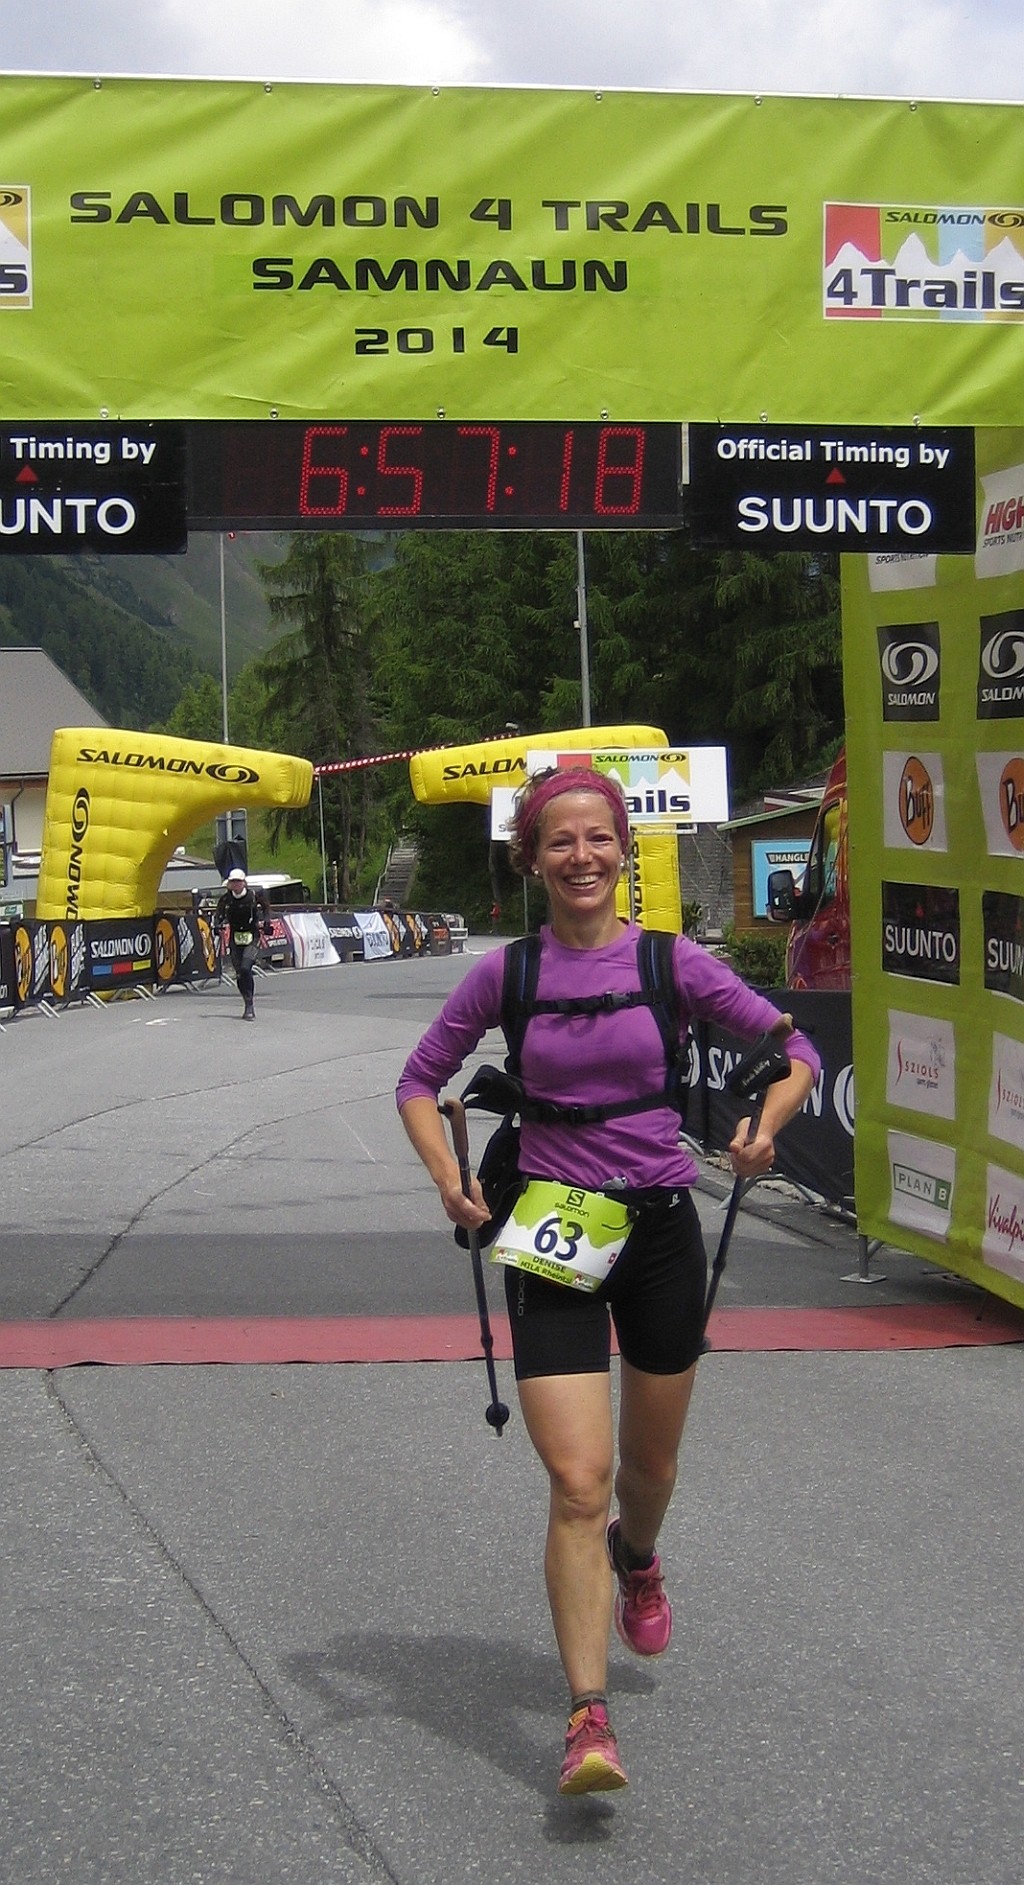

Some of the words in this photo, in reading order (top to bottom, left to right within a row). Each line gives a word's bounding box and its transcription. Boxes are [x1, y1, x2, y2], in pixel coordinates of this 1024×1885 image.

[70, 191, 439, 229] SALOMON
[469, 198, 512, 231] 4
[541, 200, 788, 236] TRAILS
[885, 211, 986, 225] SALOMON
[252, 257, 628, 292] SAMNAUN
[354, 326, 518, 355] 2014
[10, 437, 111, 463] Timing
[122, 437, 156, 464] by
[717, 438, 812, 462] Official
[820, 440, 909, 467] Timing
[919, 444, 950, 469] by
[299, 426, 645, 516] 6:57:18
[0, 497, 136, 535] UNTO
[737, 497, 932, 535] SUUNTO
[887, 693, 936, 706] SALOMON
[981, 685, 1024, 702] SALOM
[76, 748, 205, 775] SALOMON
[595, 754, 659, 763] SALOMON
[625, 790, 691, 813] ails
[91, 938, 134, 958] SALOMON
[885, 924, 957, 962] SUUNTO
[988, 938, 1024, 976] SUUN
[1002, 1089, 1024, 1108] SZIOL
[898, 1172, 933, 1196] PLAN
[938, 1186, 947, 1201] B
[554, 1202, 590, 1218] salomon
[534, 1217, 584, 1262] 63
[532, 1256, 567, 1274] DENISE
